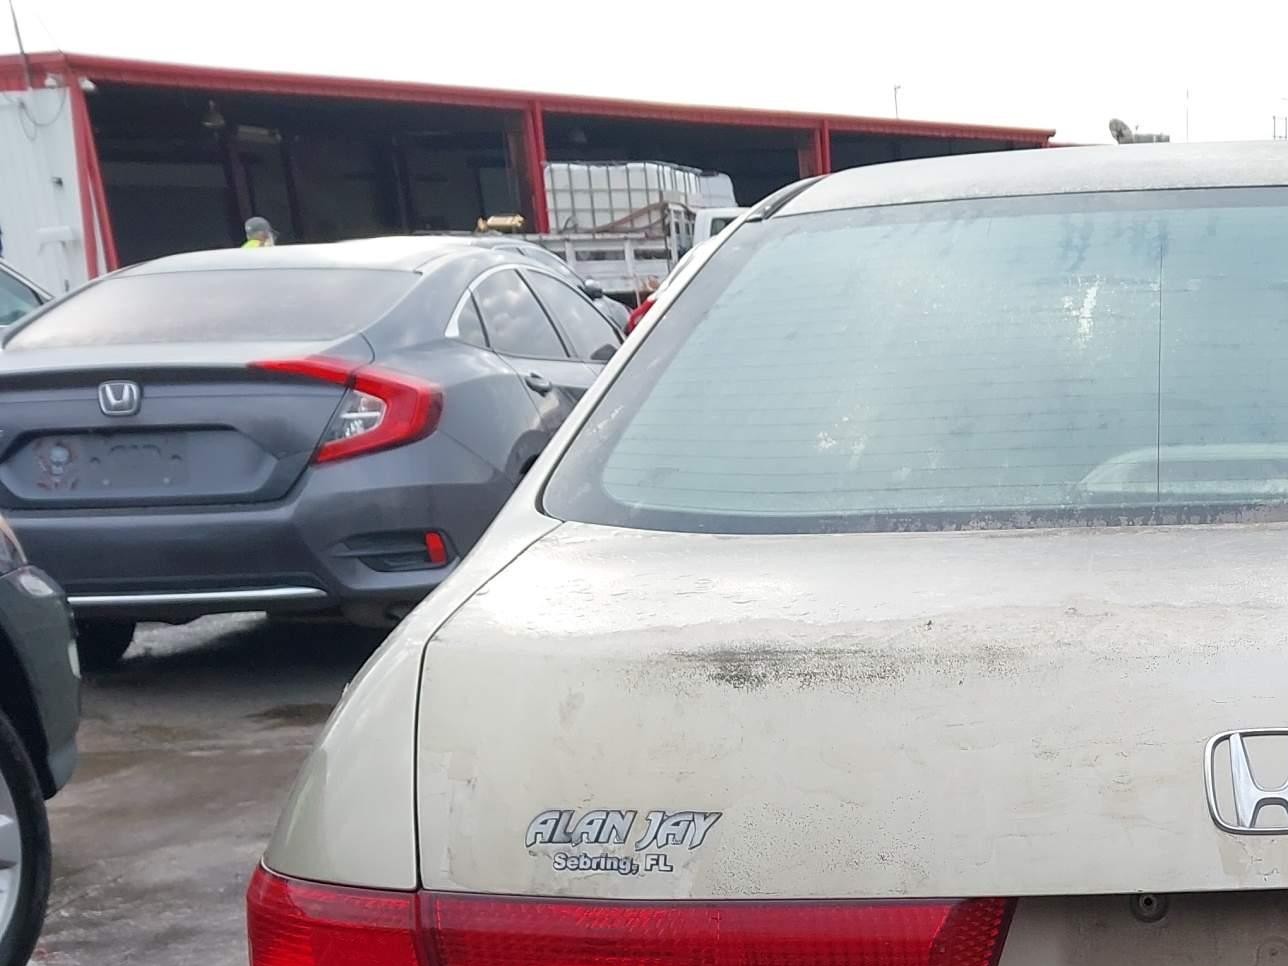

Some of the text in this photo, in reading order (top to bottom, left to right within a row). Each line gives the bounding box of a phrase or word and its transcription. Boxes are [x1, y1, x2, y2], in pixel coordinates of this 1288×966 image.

[525, 809, 723, 851] ALAN JAY
[552, 852, 673, 875] Sebring, FL
